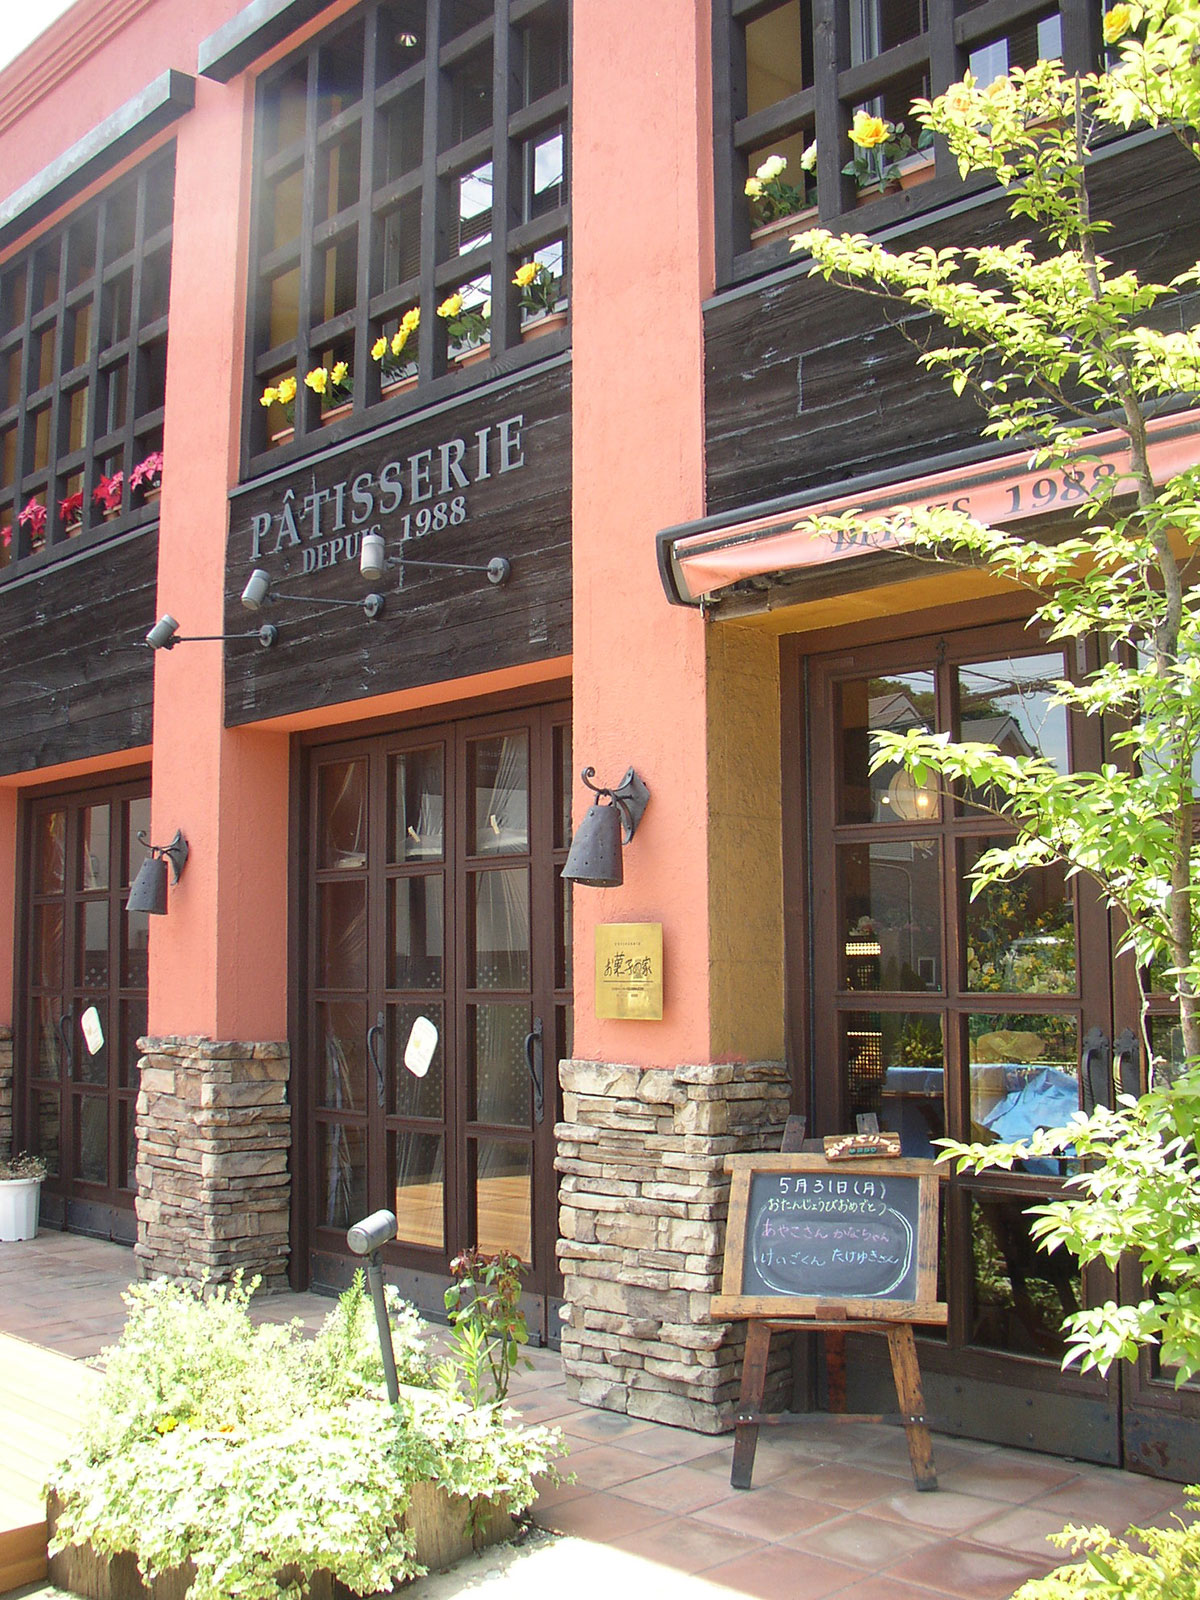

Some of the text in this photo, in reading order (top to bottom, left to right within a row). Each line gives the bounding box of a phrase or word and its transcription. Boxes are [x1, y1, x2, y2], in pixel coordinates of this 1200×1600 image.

[250, 414, 524, 560] PÂTISSERIE
[400, 496, 466, 542] 1988
[603, 950, 653, 977] お菓子の家
[780, 1177, 886, 1199] 5月31日(月)
[768, 1198, 887, 1216] おたんじょうびおめでとう
[761, 1248, 826, 1266] けいごくん
